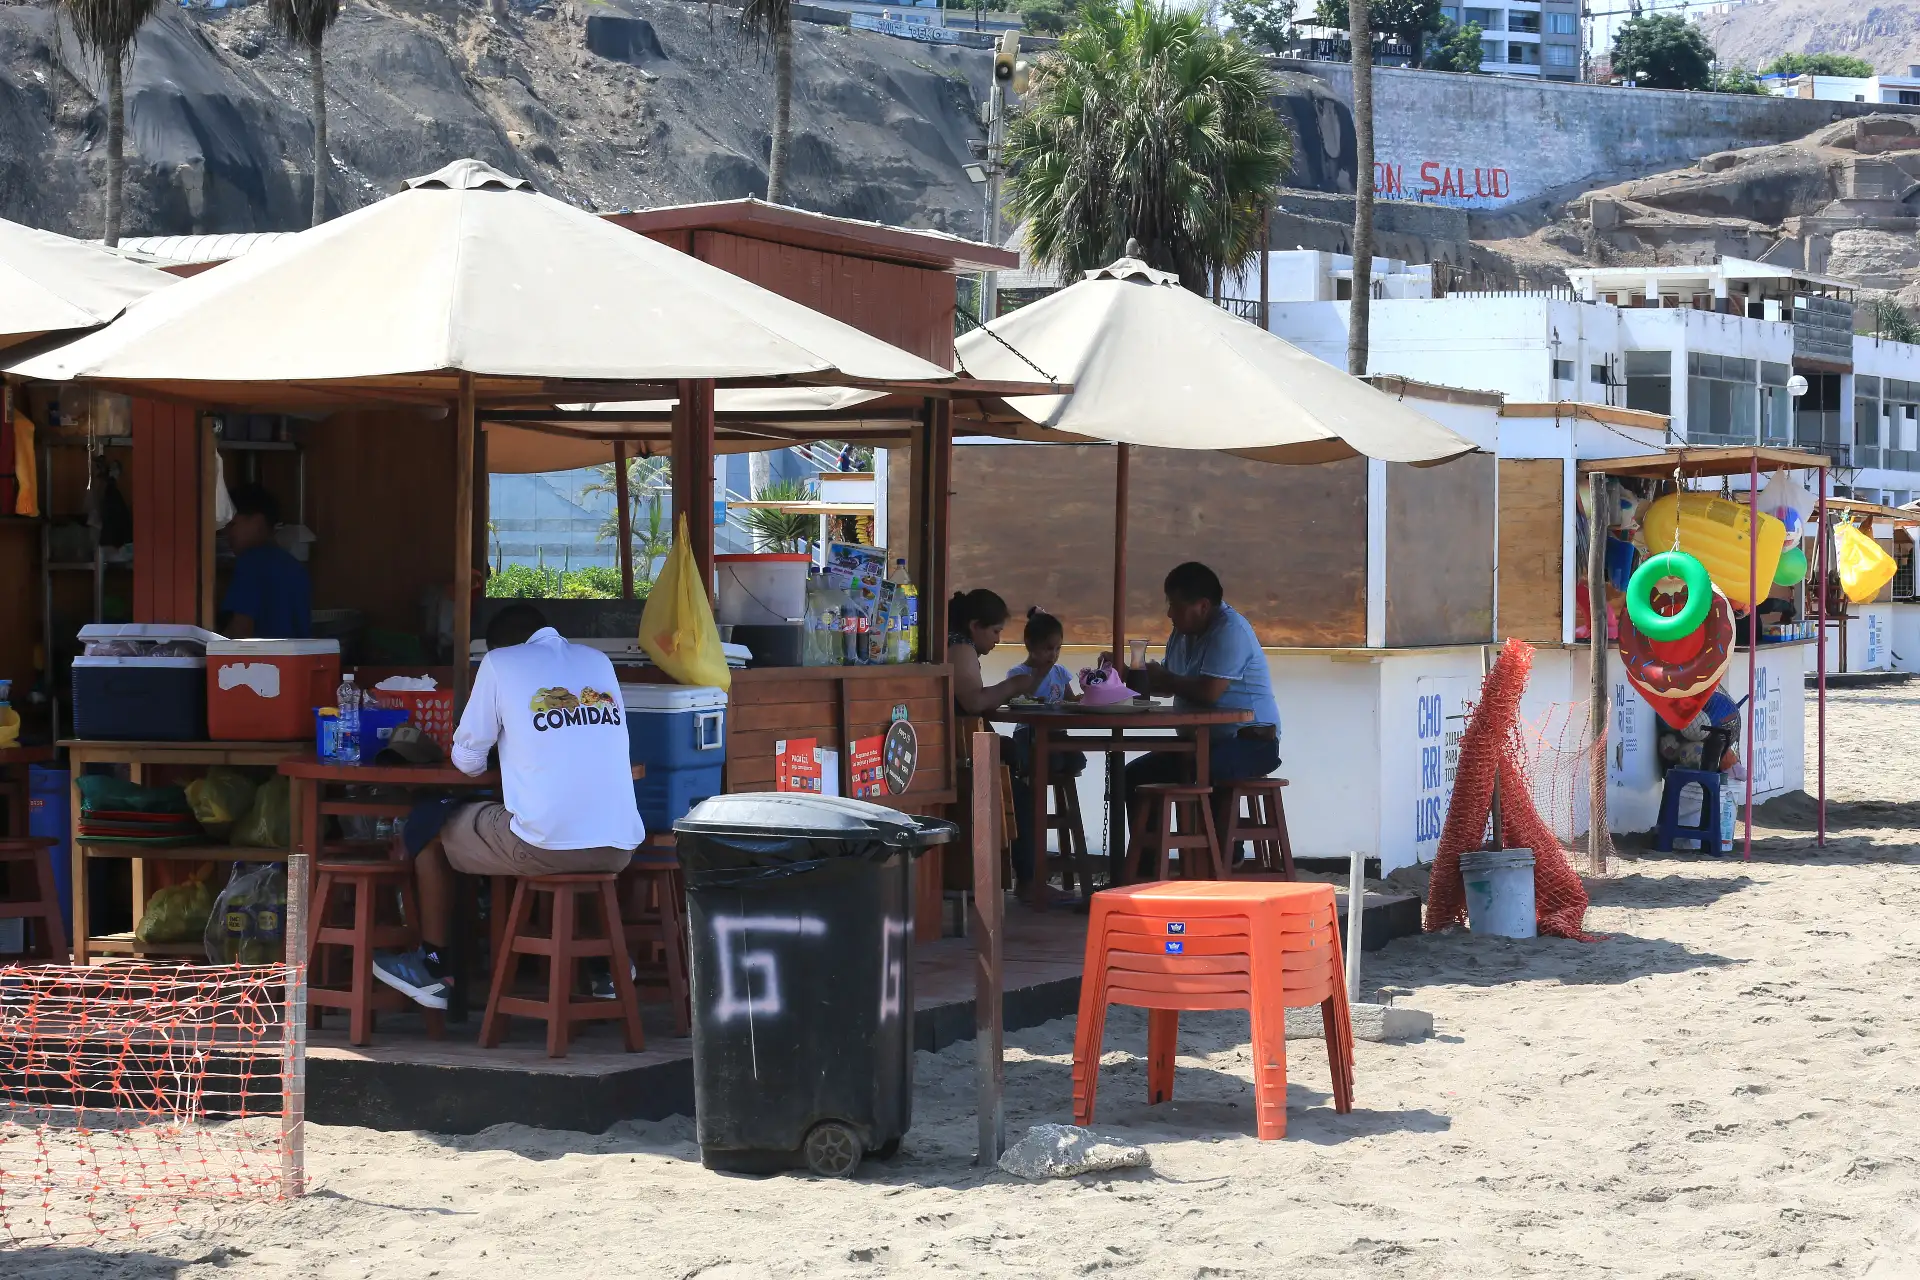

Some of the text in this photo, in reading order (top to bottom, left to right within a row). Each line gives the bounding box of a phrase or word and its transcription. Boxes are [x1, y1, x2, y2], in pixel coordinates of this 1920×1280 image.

[1381, 43, 1412, 55] OYECTO
[1420, 161, 1510, 198] SALUD
[1616, 683, 1625, 707] HO
[533, 706, 621, 732] COMIDAS
[1418, 693, 1442, 739] CHO
[1422, 745, 1441, 790] RRI
[1416, 795, 1441, 843] LLOS
